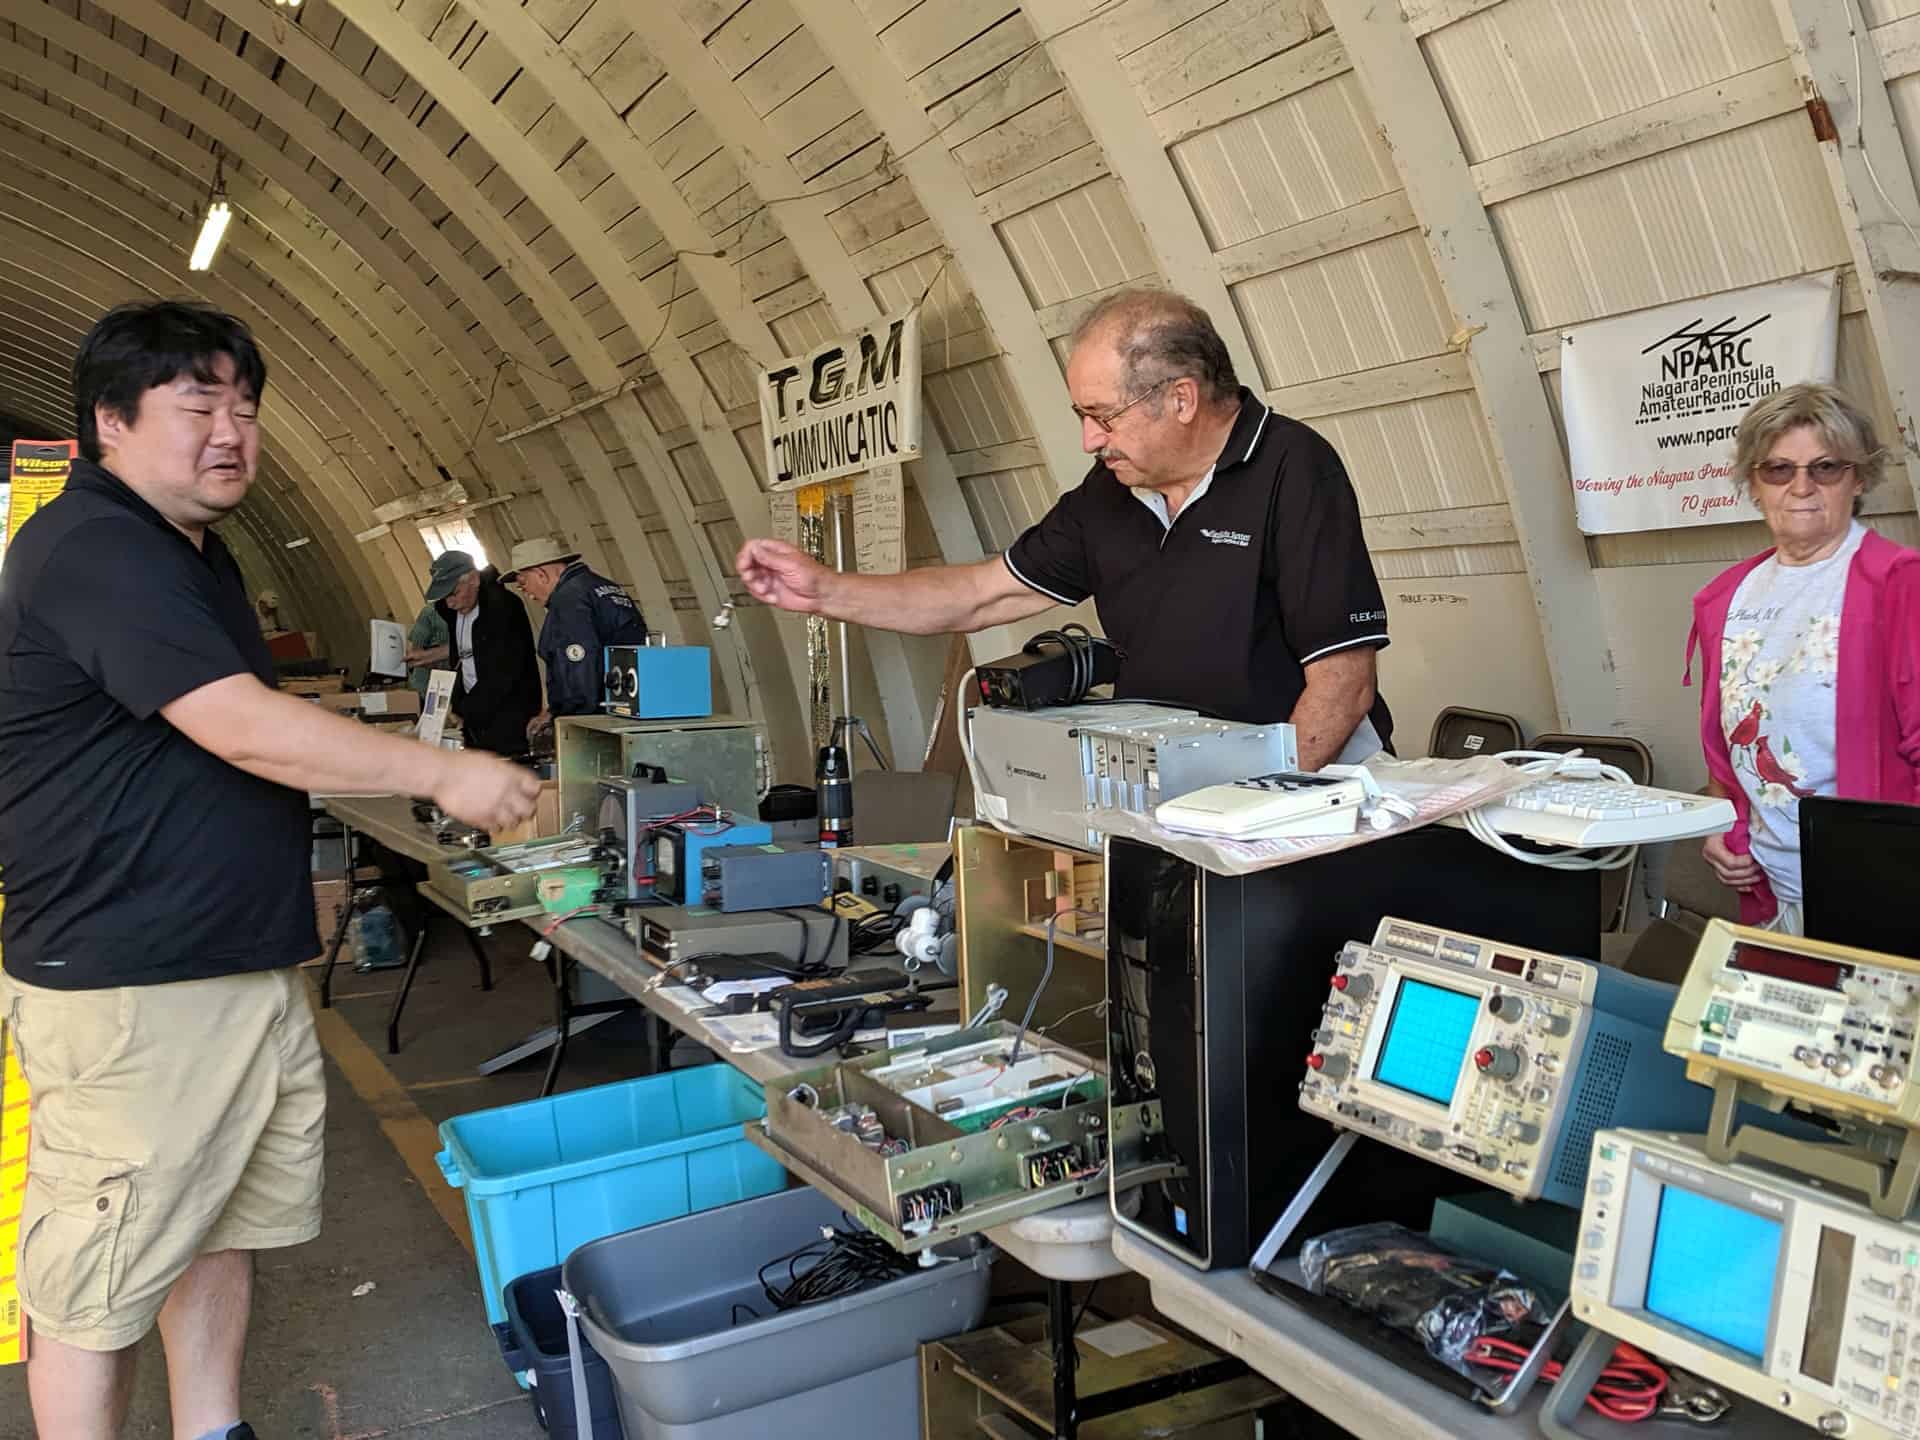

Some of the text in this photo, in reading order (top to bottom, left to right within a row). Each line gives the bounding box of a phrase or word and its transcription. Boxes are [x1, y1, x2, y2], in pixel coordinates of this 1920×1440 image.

[1661, 334, 1752, 382] NPARC
[16, 457, 71, 468] Wilson
[1576, 476, 1622, 496] Serving
[1627, 473, 1643, 489] the
[1647, 466, 1694, 490] Niagara
[1681, 485, 1742, 515] 70 years!
